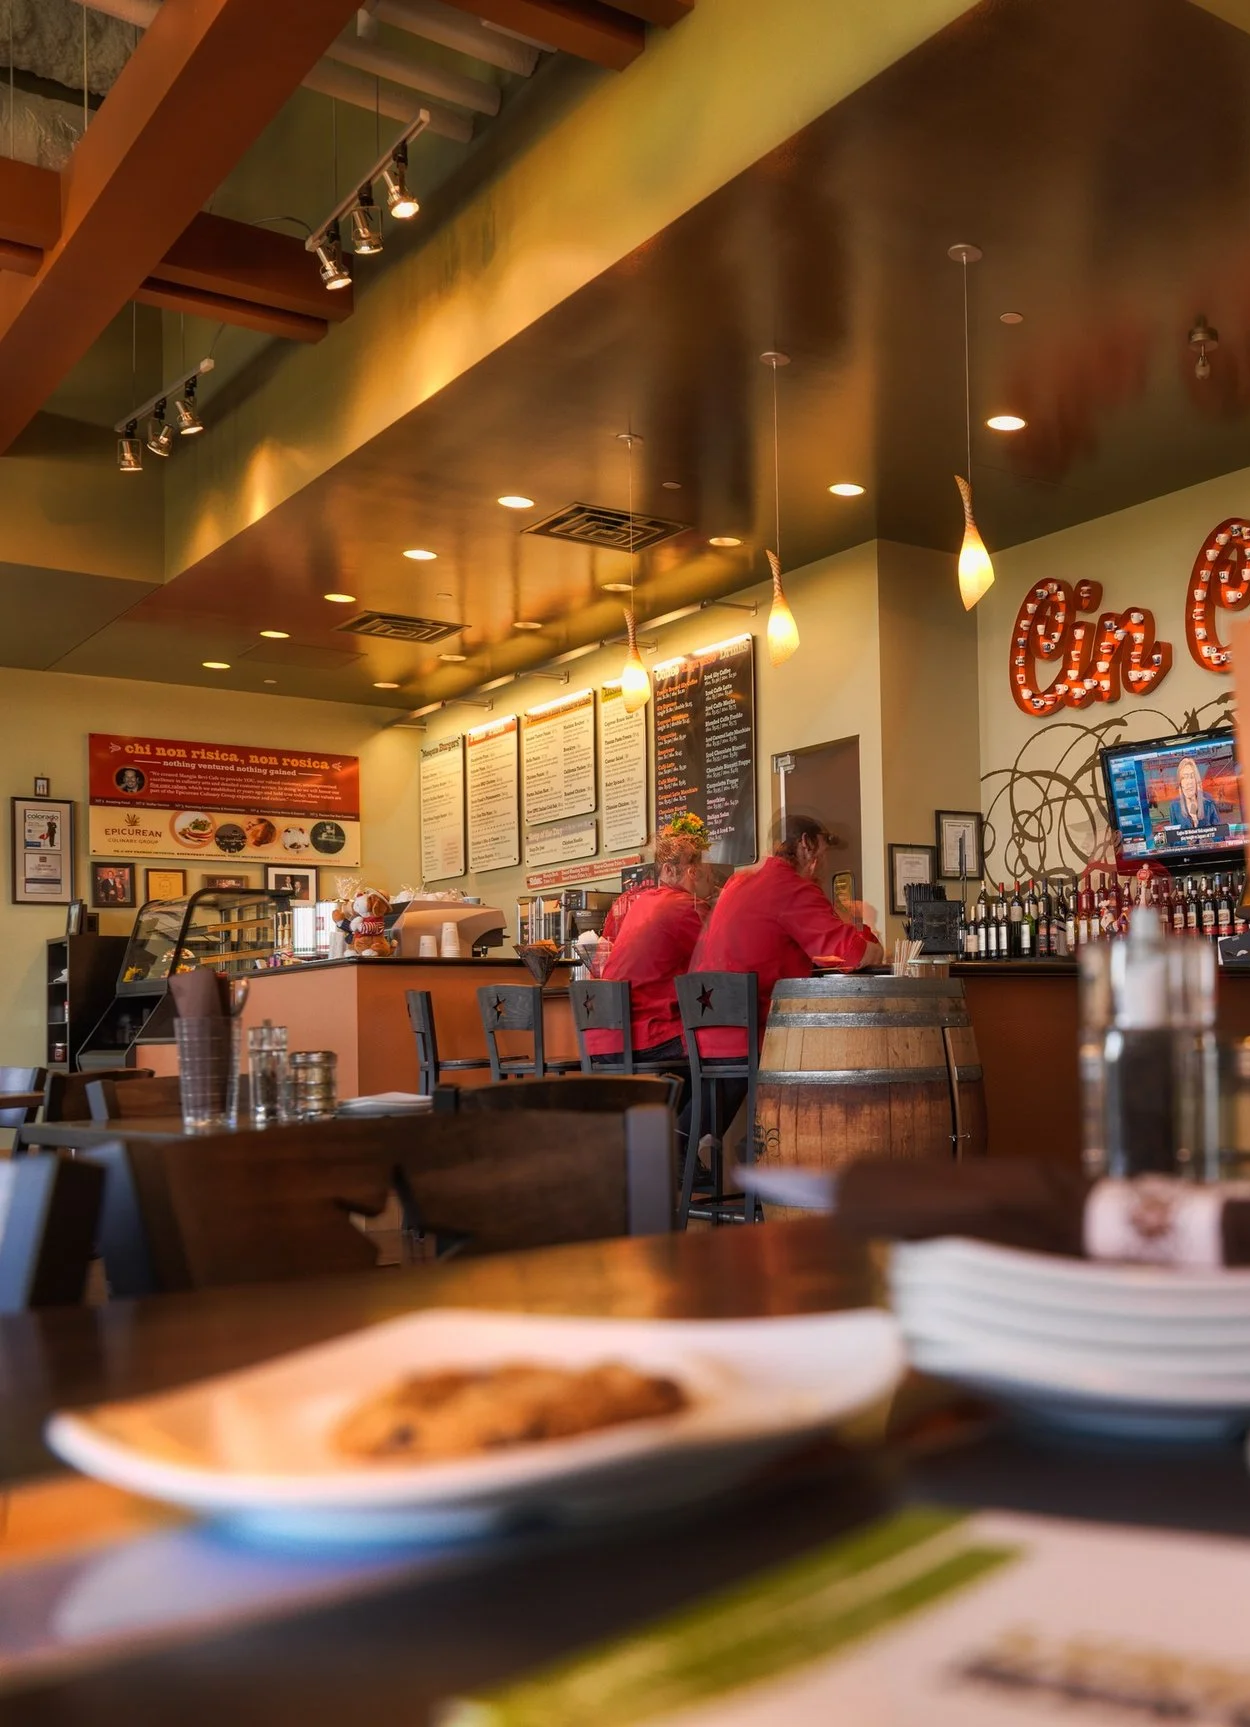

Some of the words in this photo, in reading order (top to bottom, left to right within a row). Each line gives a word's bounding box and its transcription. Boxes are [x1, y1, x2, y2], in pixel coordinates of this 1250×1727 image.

[1009, 577, 1172, 717] Cin
[124, 743, 152, 755] chi
[156, 746, 187, 758] non
[191, 748, 245, 764] risica,
[249, 754, 279, 765] non
[281, 757, 330, 770] rosica
[163, 760, 196, 770] nothing
[197, 762, 235, 772] ventured
[236, 764, 268, 775] nothing
[269, 768, 297, 777] gained
[104, 828, 162, 838] EPICUREAN
